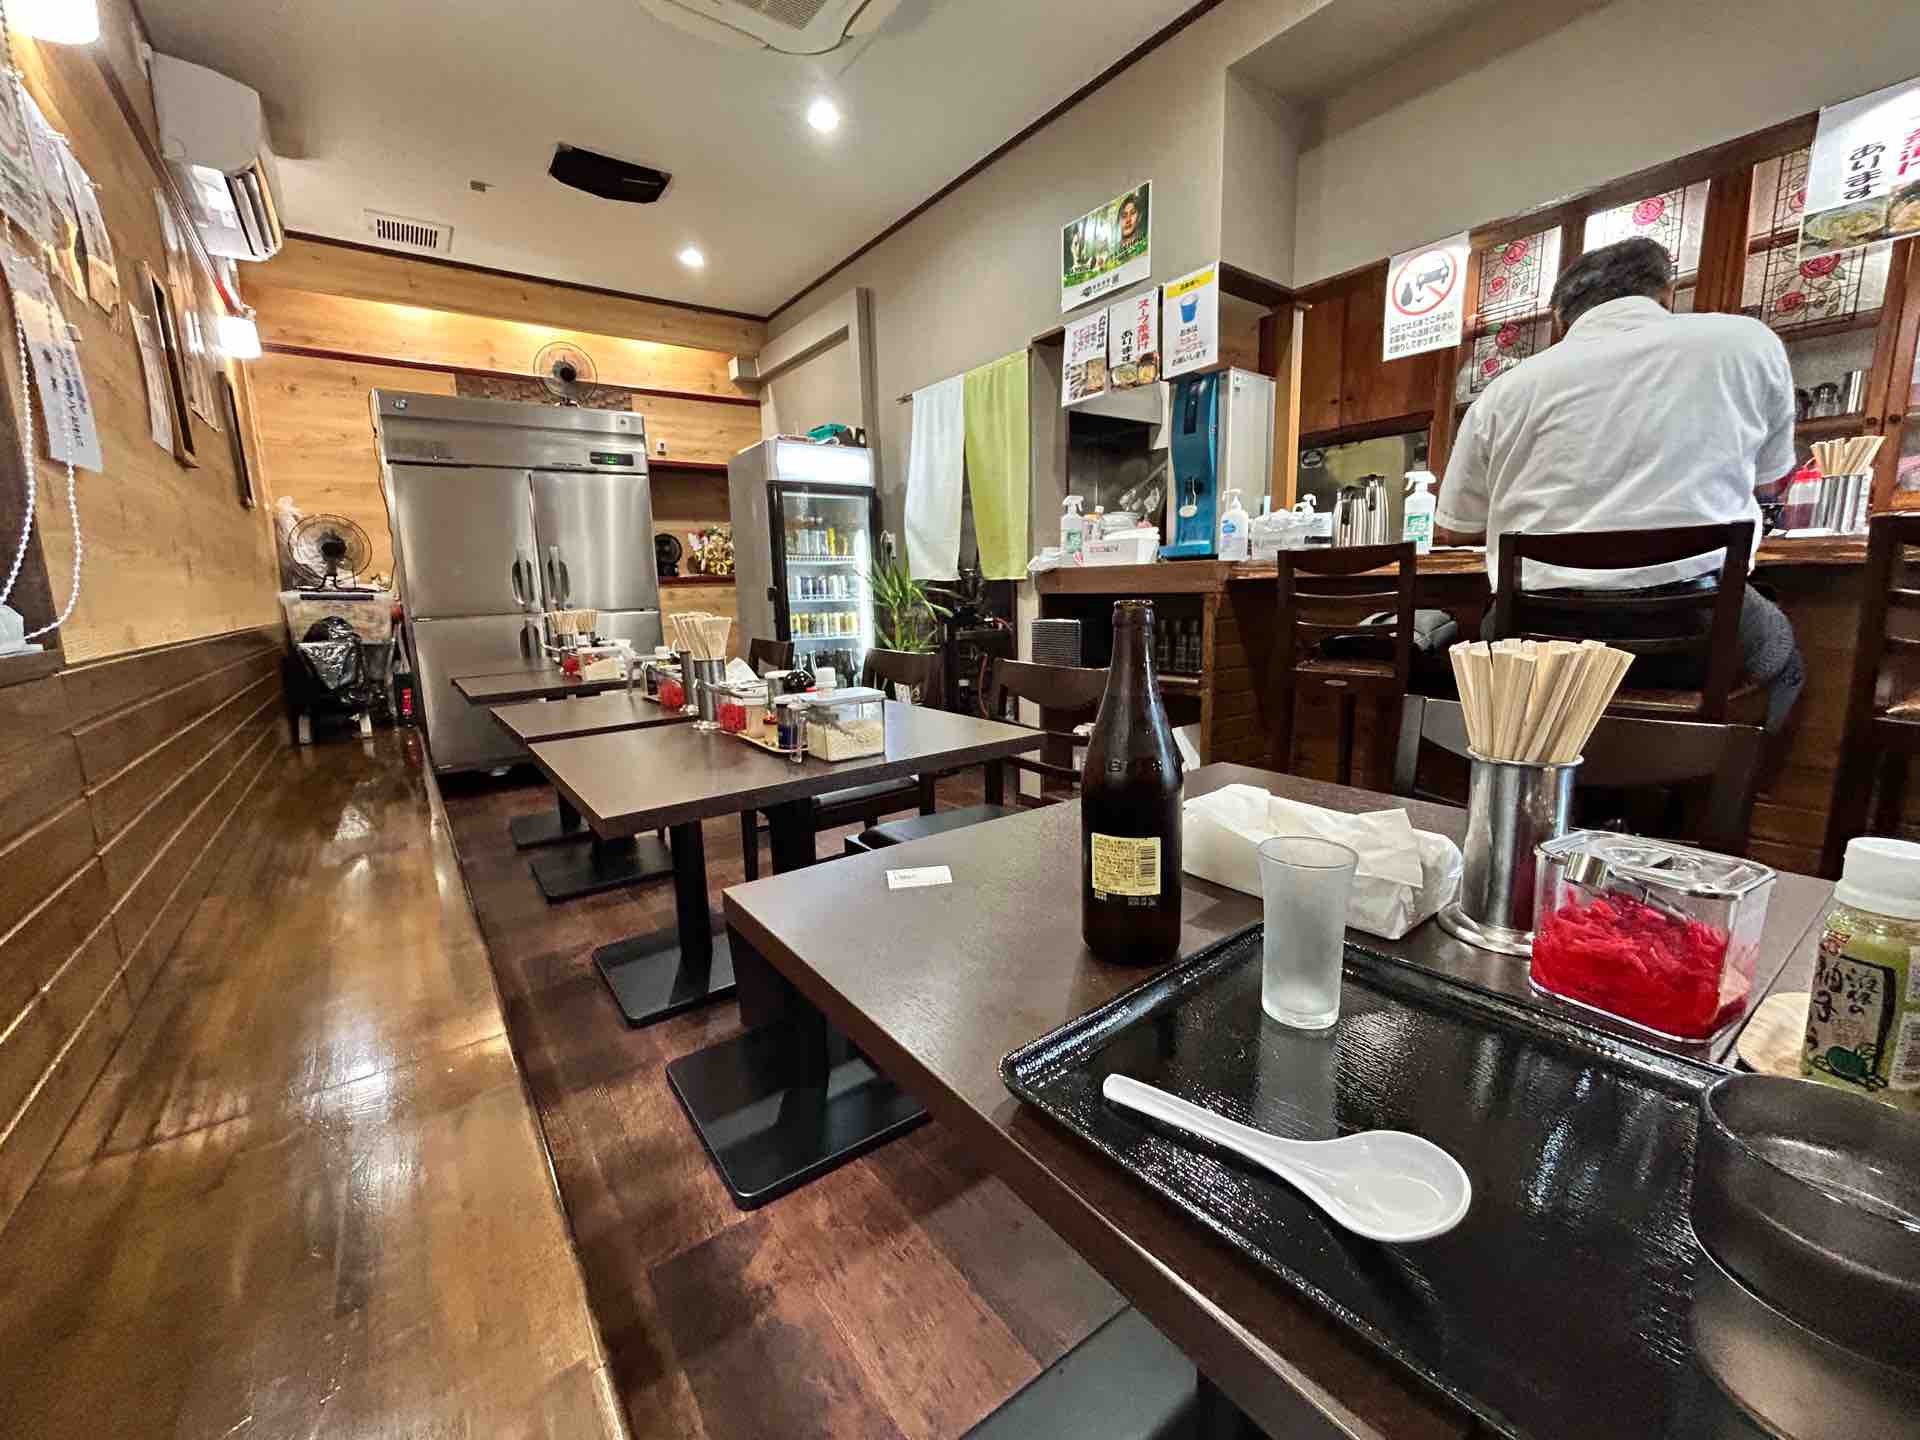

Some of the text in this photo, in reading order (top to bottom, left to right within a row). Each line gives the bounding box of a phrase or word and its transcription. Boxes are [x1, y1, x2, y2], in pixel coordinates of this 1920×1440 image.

[1843, 142, 1886, 200] あります
[1121, 329, 1134, 362] あります
